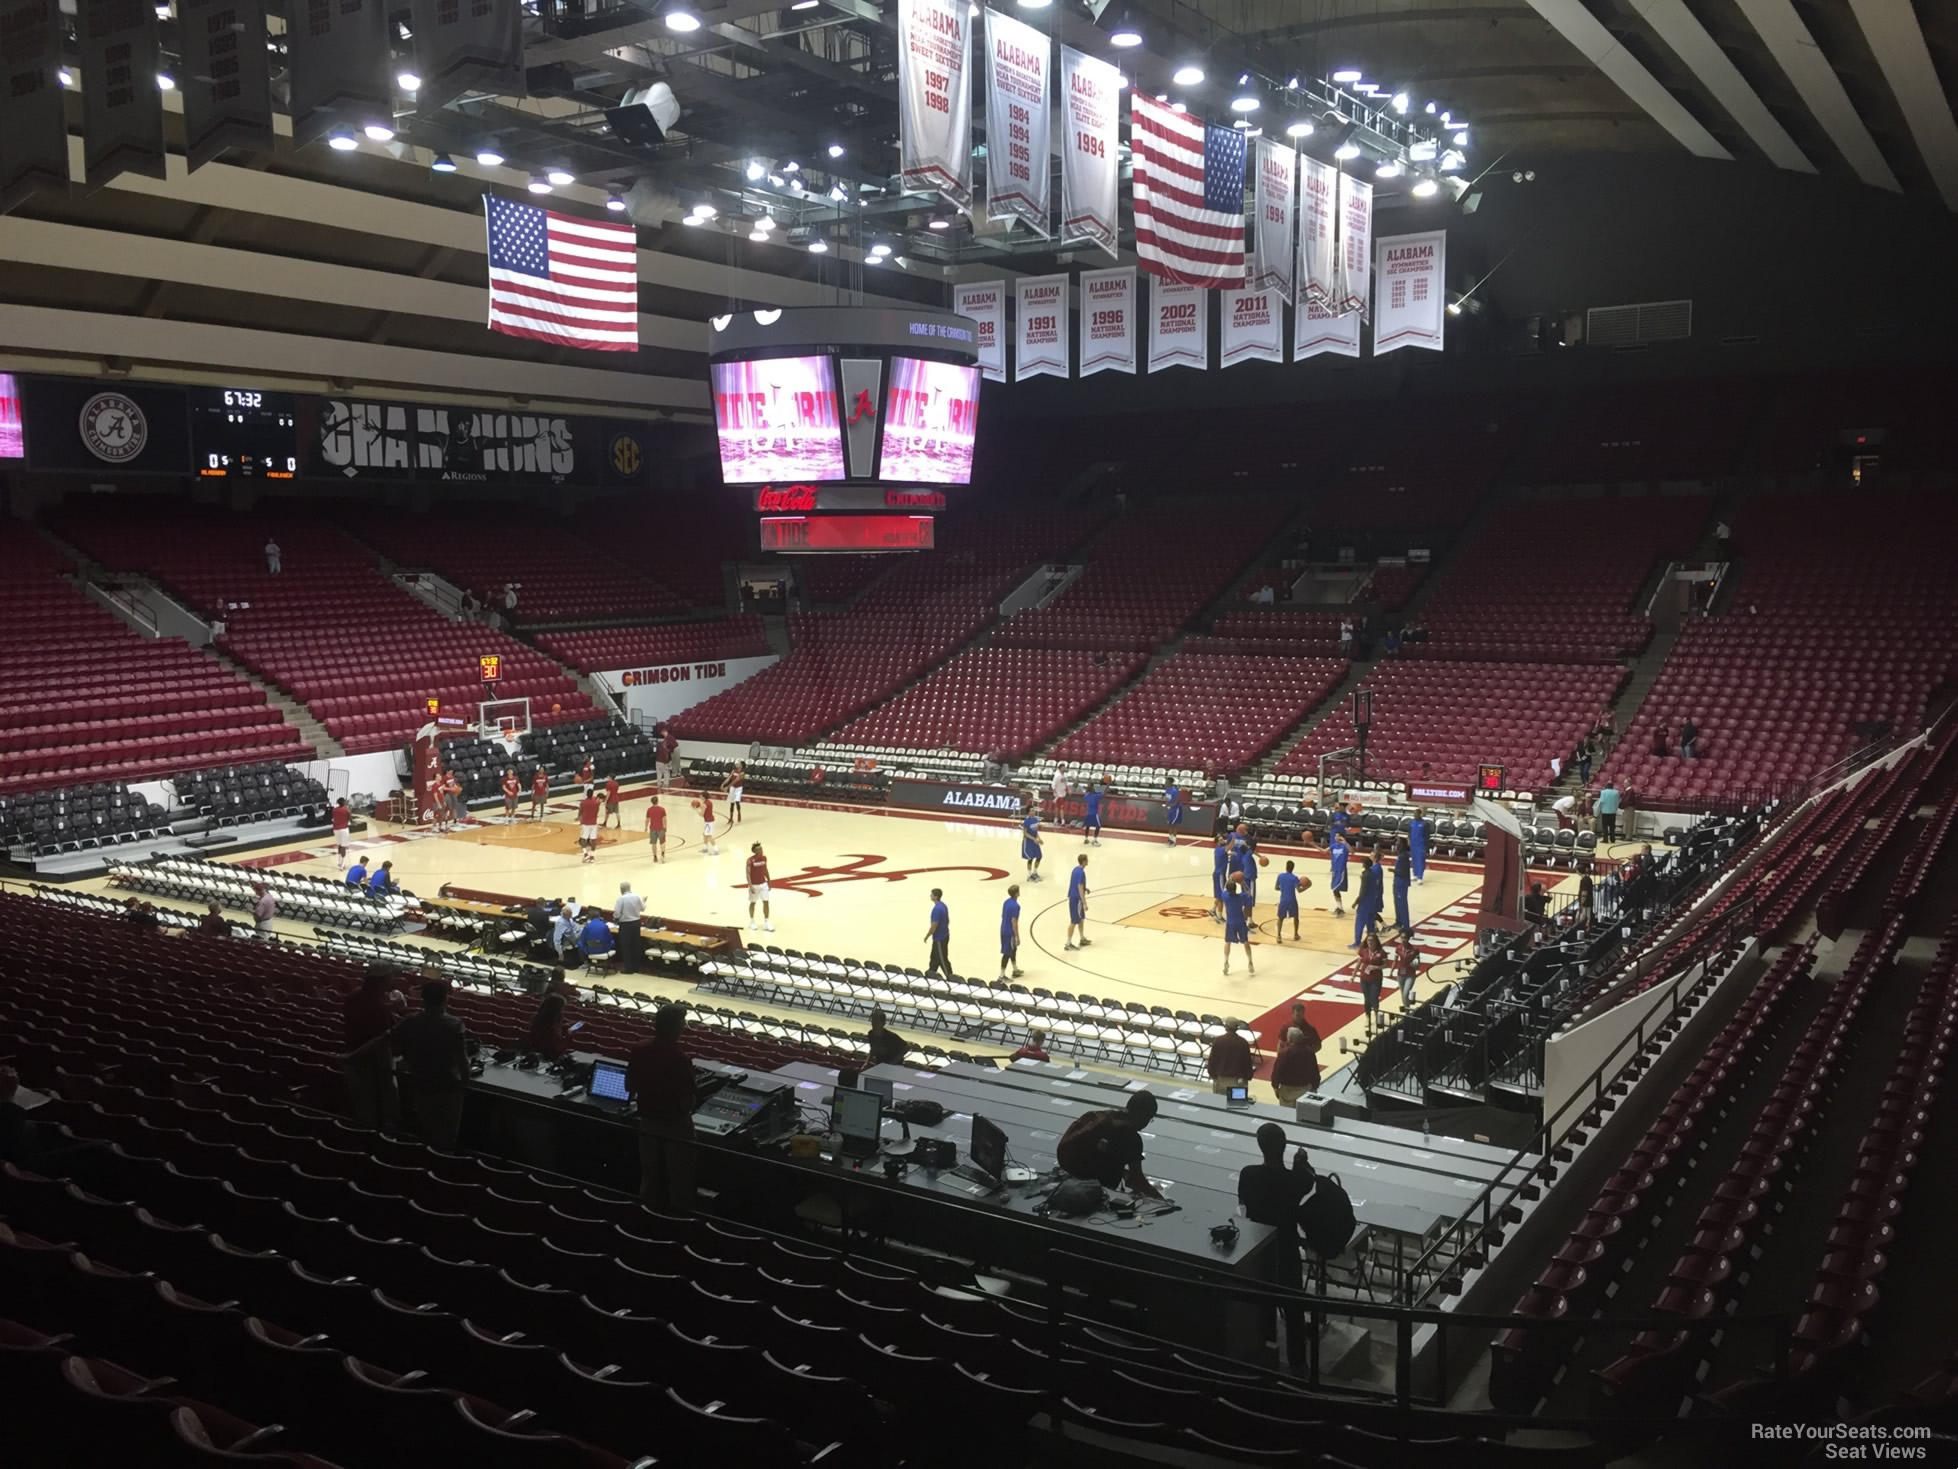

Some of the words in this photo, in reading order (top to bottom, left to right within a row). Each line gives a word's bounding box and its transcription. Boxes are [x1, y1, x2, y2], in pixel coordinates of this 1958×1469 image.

[910, 42, 934, 60] SWEET
[997, 38, 1041, 76] ALABAMA
[925, 69, 949, 93] 1997
[996, 78, 1016, 94] SWEET
[925, 90, 949, 113] 1998
[1008, 103, 1030, 125] 1984
[1008, 122, 1030, 144] 1994
[1009, 141, 1030, 162] 1995
[1077, 130, 1105, 159] 1994
[1008, 160, 1030, 182] 1996
[1266, 204, 1285, 225] 1994
[1387, 245, 1434, 262] ALABAMA
[1391, 260, 1429, 269] GYMNASTICS
[1399, 265, 1434, 274] CHAMPIONS
[1024, 286, 1060, 300] ALABAMA
[1088, 280, 1128, 294] ALABAMA
[962, 292, 997, 306] ALABAMA
[1235, 296, 1269, 313] 2011
[1092, 310, 1124, 326] 1996
[1160, 304, 1197, 320] 2002
[1233, 311, 1271, 321] NATIONAL
[909, 322, 928, 336] HOME
[928, 324, 936, 336] OF
[937, 325, 947, 338] THE
[978, 321, 995, 335] 88
[1028, 316, 1057, 331] 1991
[1090, 325, 1126, 334] NATIONAL
[1160, 319, 1197, 328] NATIONAL
[1160, 326, 1197, 335] CHAMPIONS
[1233, 318, 1271, 328] CHAMPIONS
[1026, 330, 1058, 339] NATIONAL
[1026, 337, 1058, 345] CHAMPIONS
[1090, 331, 1126, 340] CHAMPIONS
[224, 390, 262, 408] 67:32
[88, 400, 139, 426] ALABAMA
[209, 453, 219, 469] 0
[221, 455, 229, 466] 5
[265, 457, 273, 467] 5
[287, 457, 297, 472] 0
[614, 435, 641, 476] SEC
[484, 665, 497, 679] 30
[621, 666, 691, 687] CRIMSON
[694, 662, 726, 680] TIDE
[942, 790, 1022, 811] ALABAMA
[1107, 799, 1149, 822] TIDE
